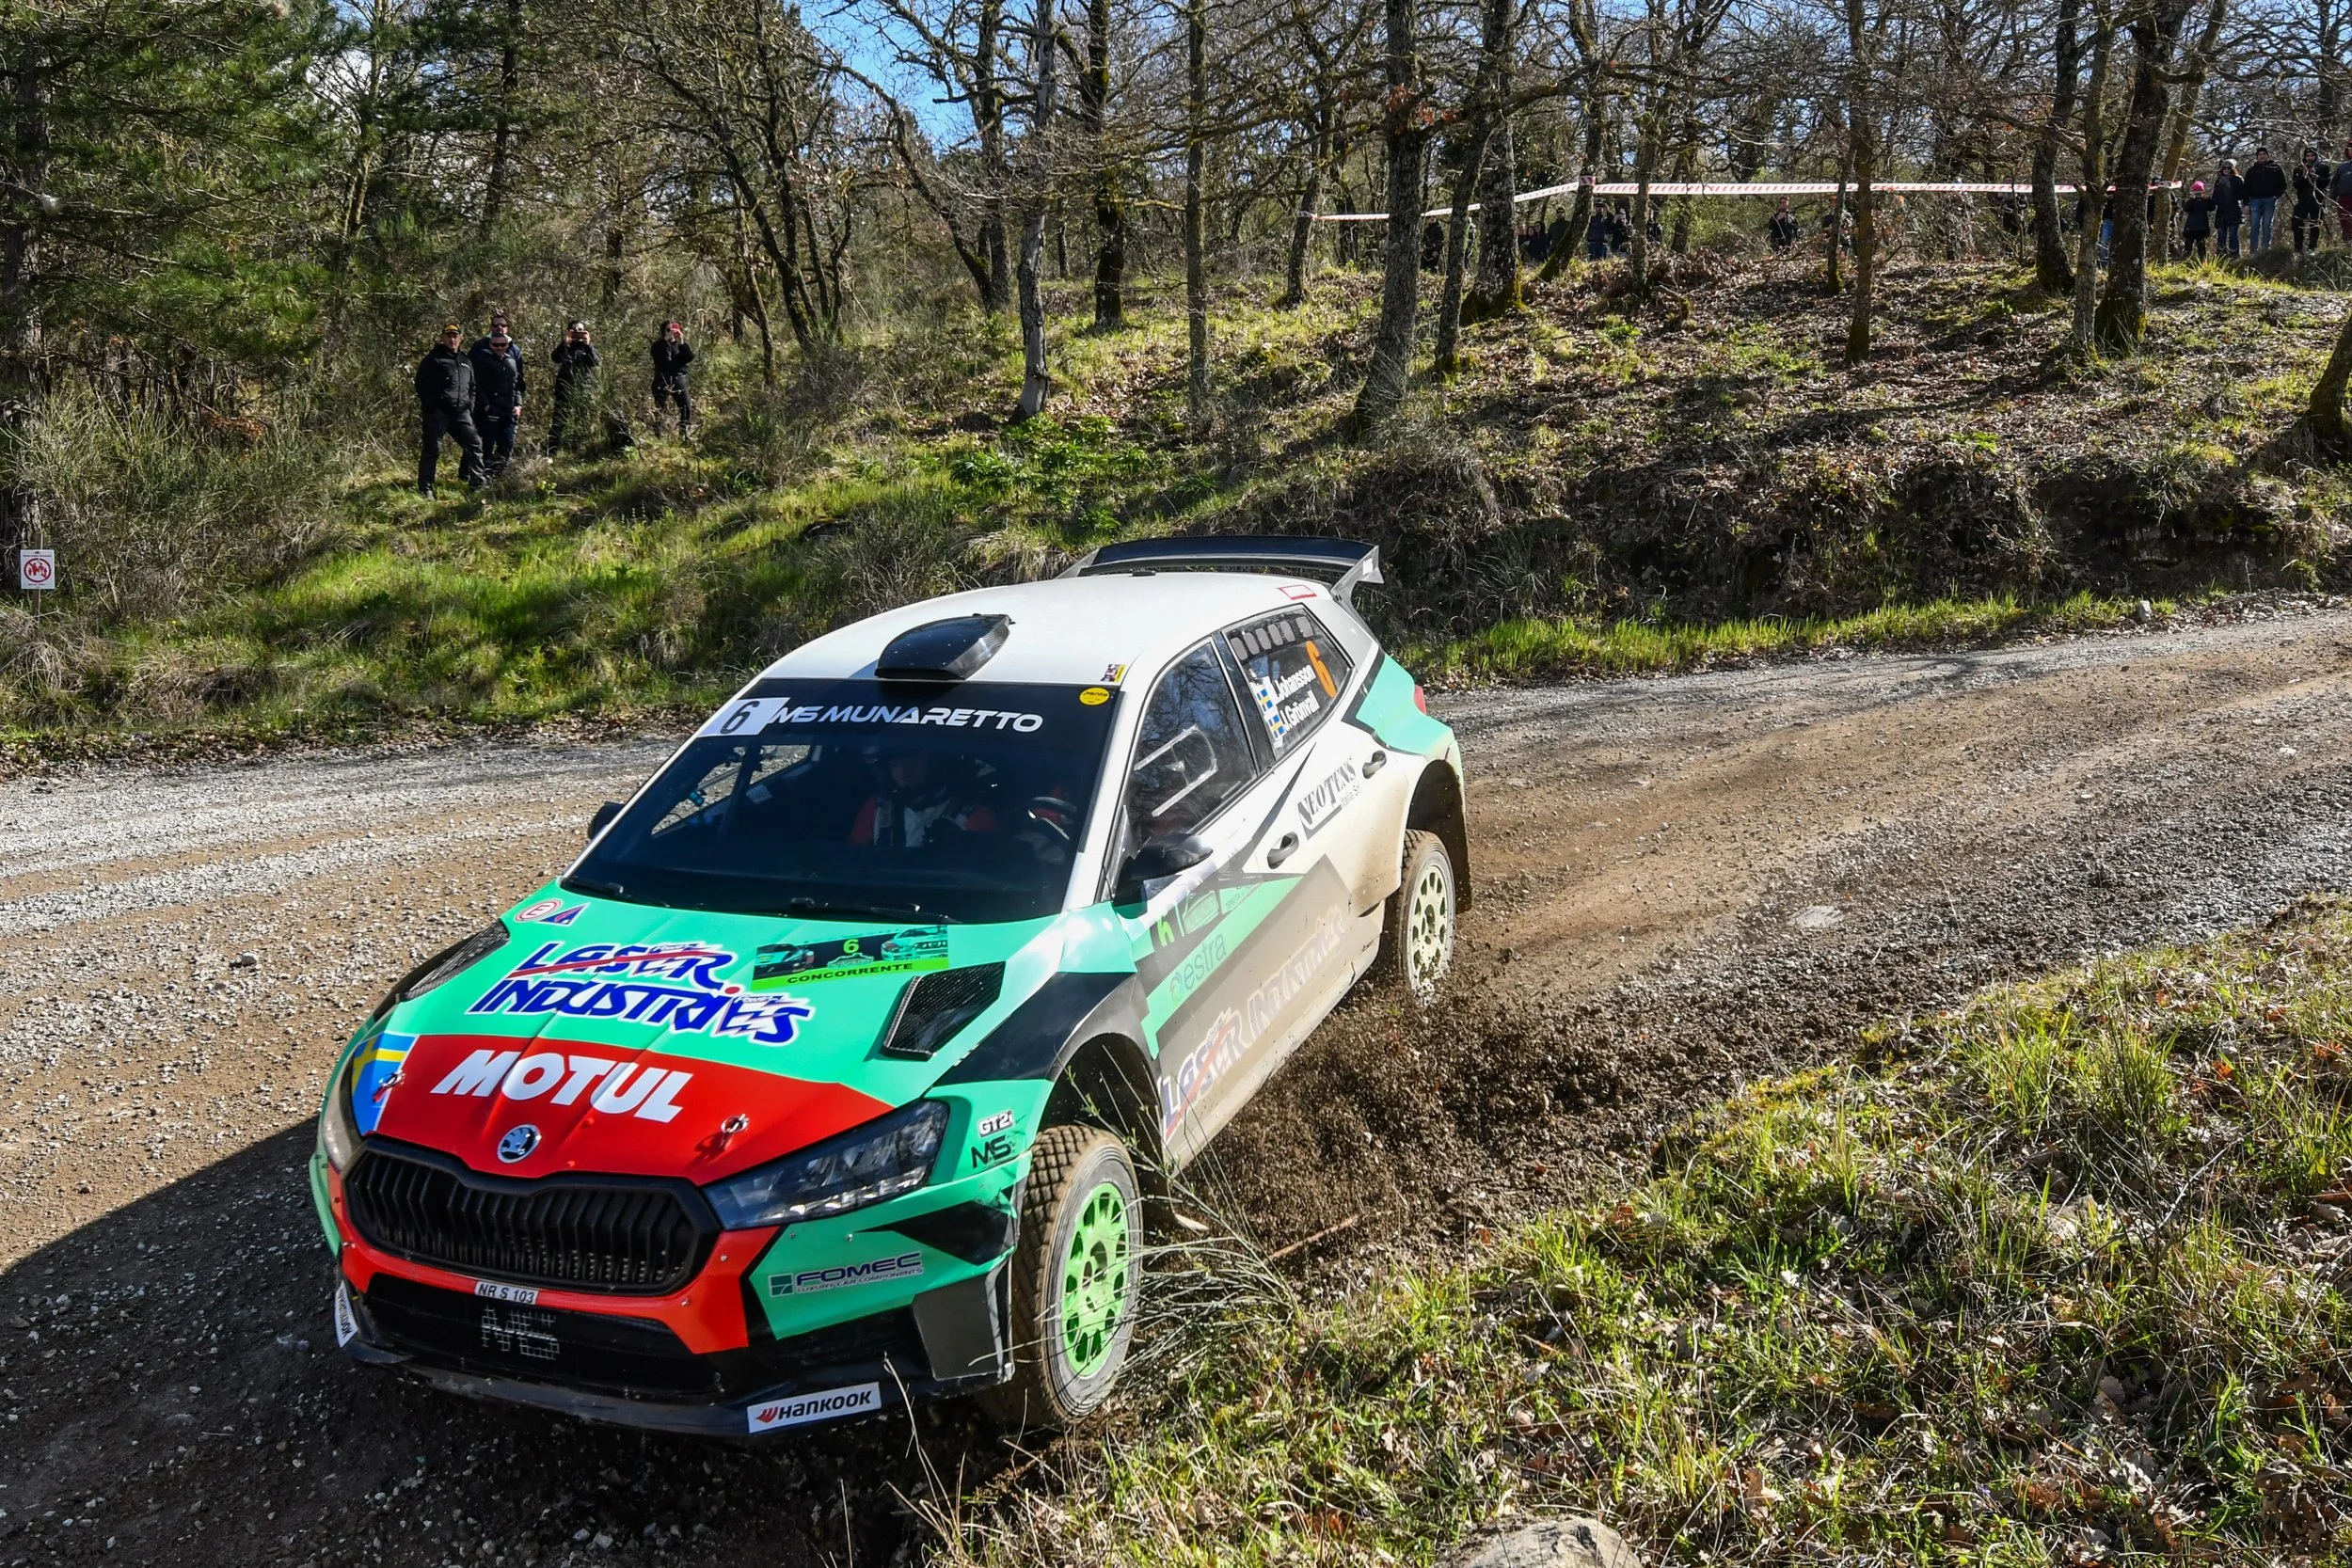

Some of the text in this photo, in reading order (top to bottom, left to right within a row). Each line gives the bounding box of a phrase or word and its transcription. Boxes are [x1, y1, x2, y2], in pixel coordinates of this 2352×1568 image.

[1305, 640, 1337, 699] 6
[720, 700, 760, 735] 6
[818, 705, 1043, 733] MUNARETTO
[526, 904, 551, 916] E
[843, 939, 861, 954] 6
[507, 941, 734, 992] LASER
[787, 962, 914, 984] CONCORRENTE
[468, 978, 813, 1043] INDUSTRIES
[429, 1049, 694, 1123] MOTUL
[797, 1252, 921, 1286] FOMEC
[478, 1283, 535, 1304] NR S 103
